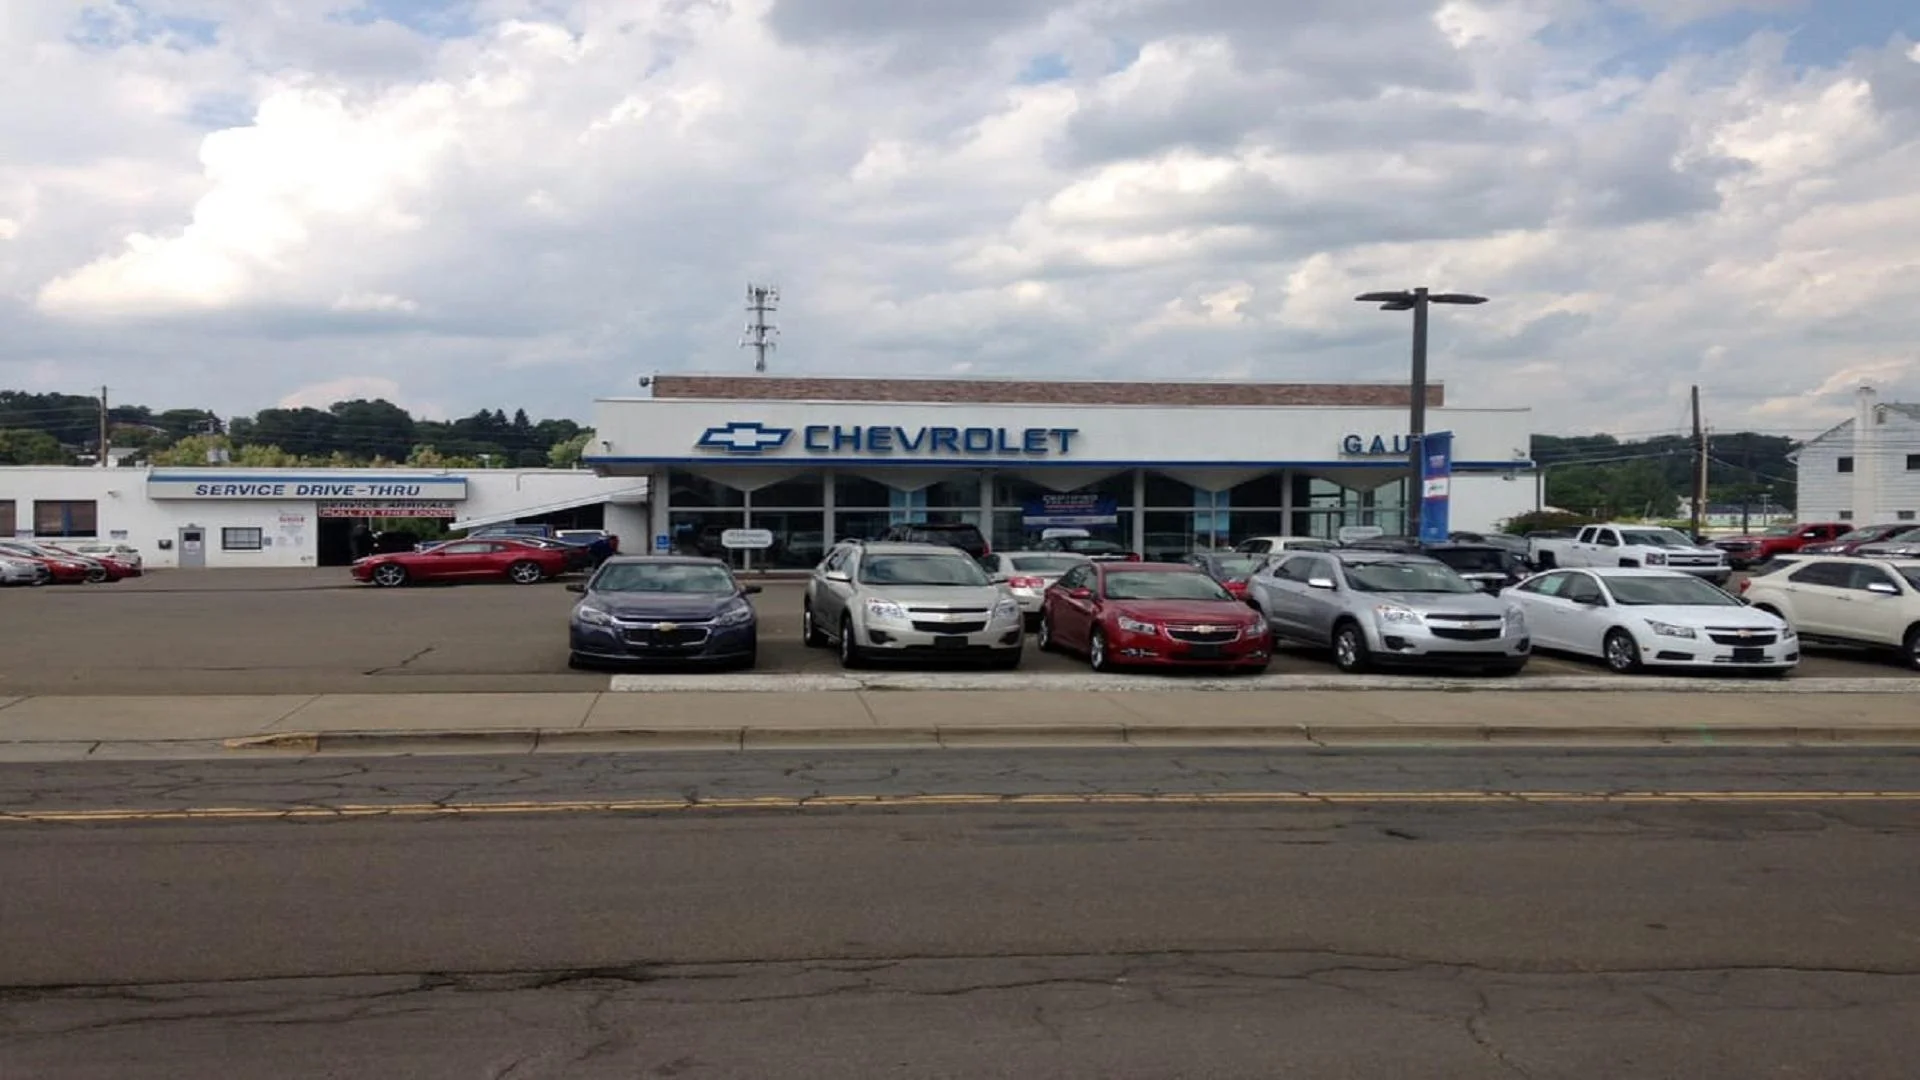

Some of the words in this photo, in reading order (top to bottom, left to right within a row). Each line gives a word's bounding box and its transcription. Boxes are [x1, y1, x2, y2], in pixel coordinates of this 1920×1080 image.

[804, 425, 1079, 453] CHEVROLET
[195, 484, 285, 496] SERVICE
[295, 484, 420, 496] DRIVE-THRU
